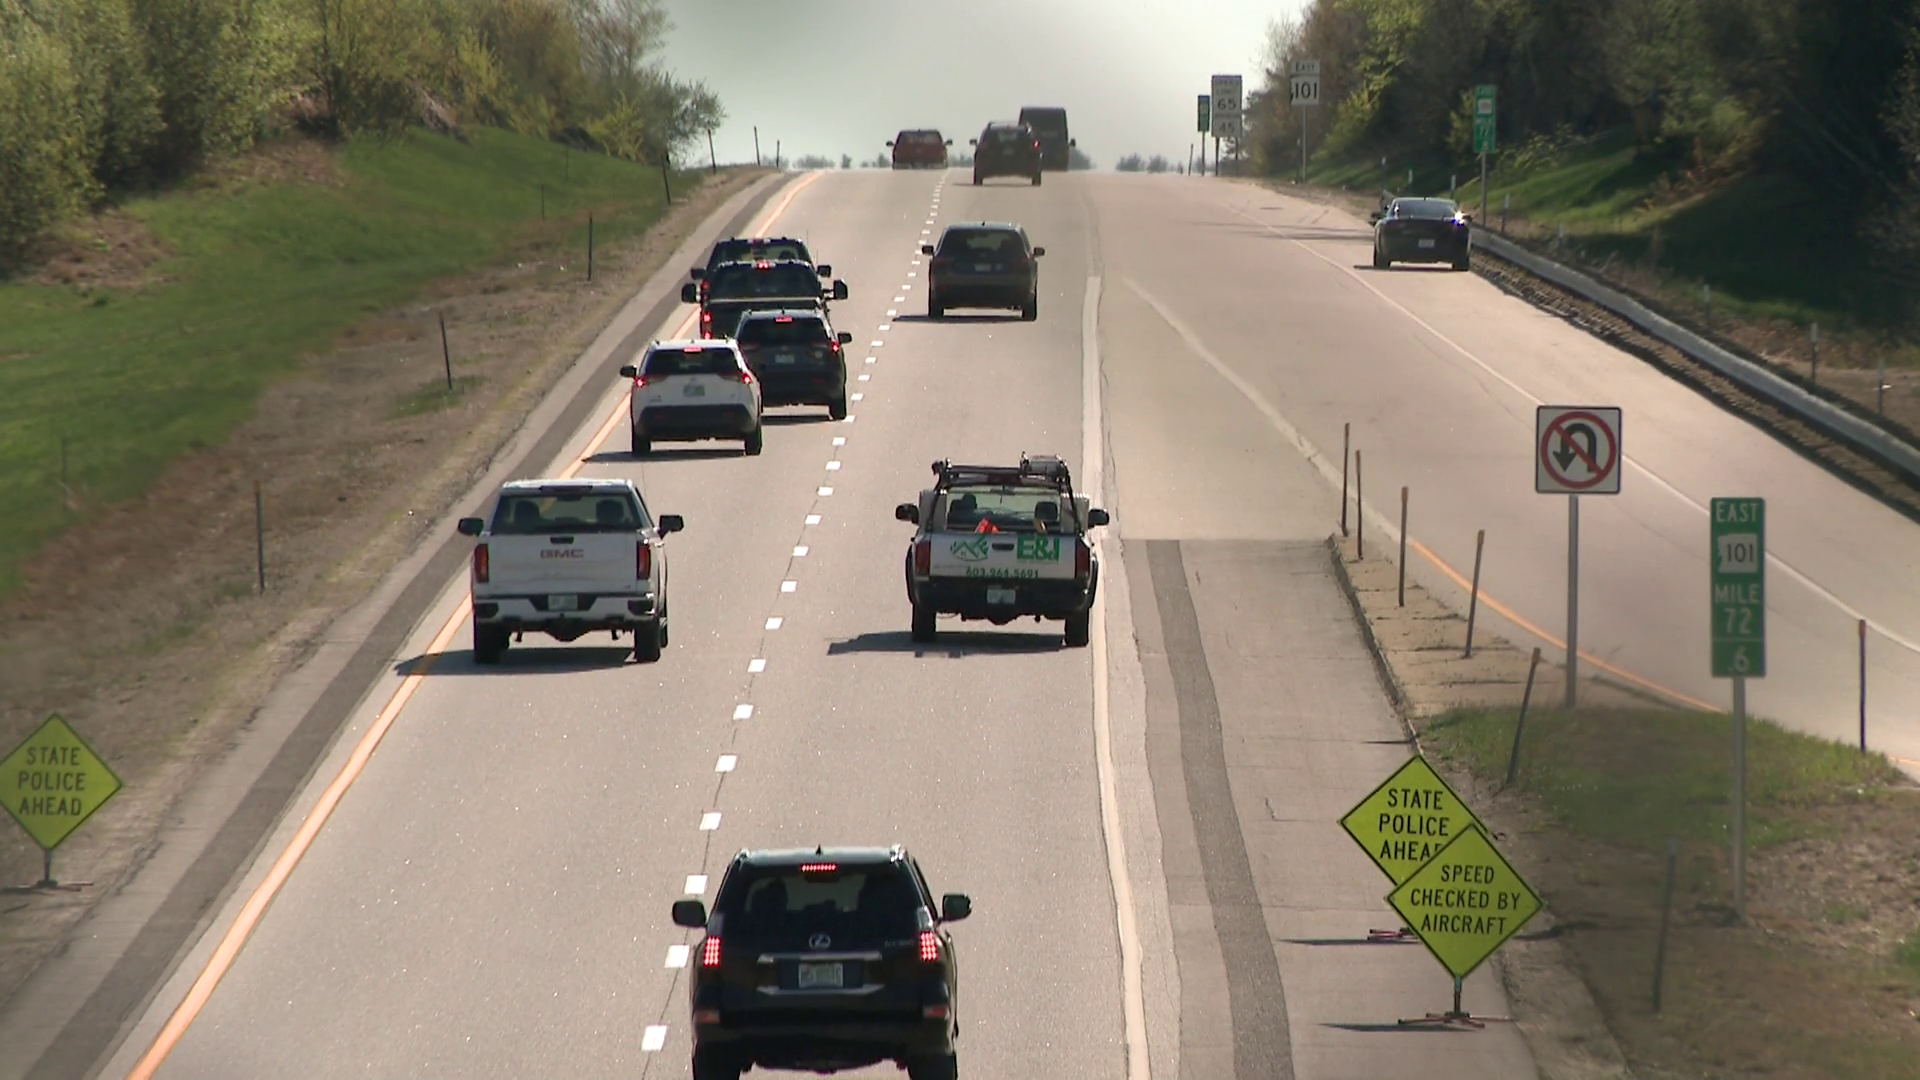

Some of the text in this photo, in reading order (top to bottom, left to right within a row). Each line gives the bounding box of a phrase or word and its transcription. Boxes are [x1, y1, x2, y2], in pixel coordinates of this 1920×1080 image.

[1295, 82, 1317, 99] 101
[1217, 97, 1237, 110] 65
[1219, 122, 1236, 133] 45
[1715, 501, 1759, 523] EAST
[540, 549, 584, 558] GMC
[1017, 535, 1060, 562] E&J
[1726, 543, 1754, 563] 101
[1715, 584, 1759, 604] MILE
[1724, 608, 1752, 635] 72
[26, 746, 81, 766] STATE
[18, 771, 87, 791] POLICE
[19, 796, 82, 816] AHEAD
[1388, 788, 1443, 811] STATE
[1379, 813, 1450, 837] POLICE
[1441, 864, 1495, 884] SPEED
[1410, 888, 1521, 911] CHECKED BY
[1421, 914, 1507, 935] AIRCRAFT
